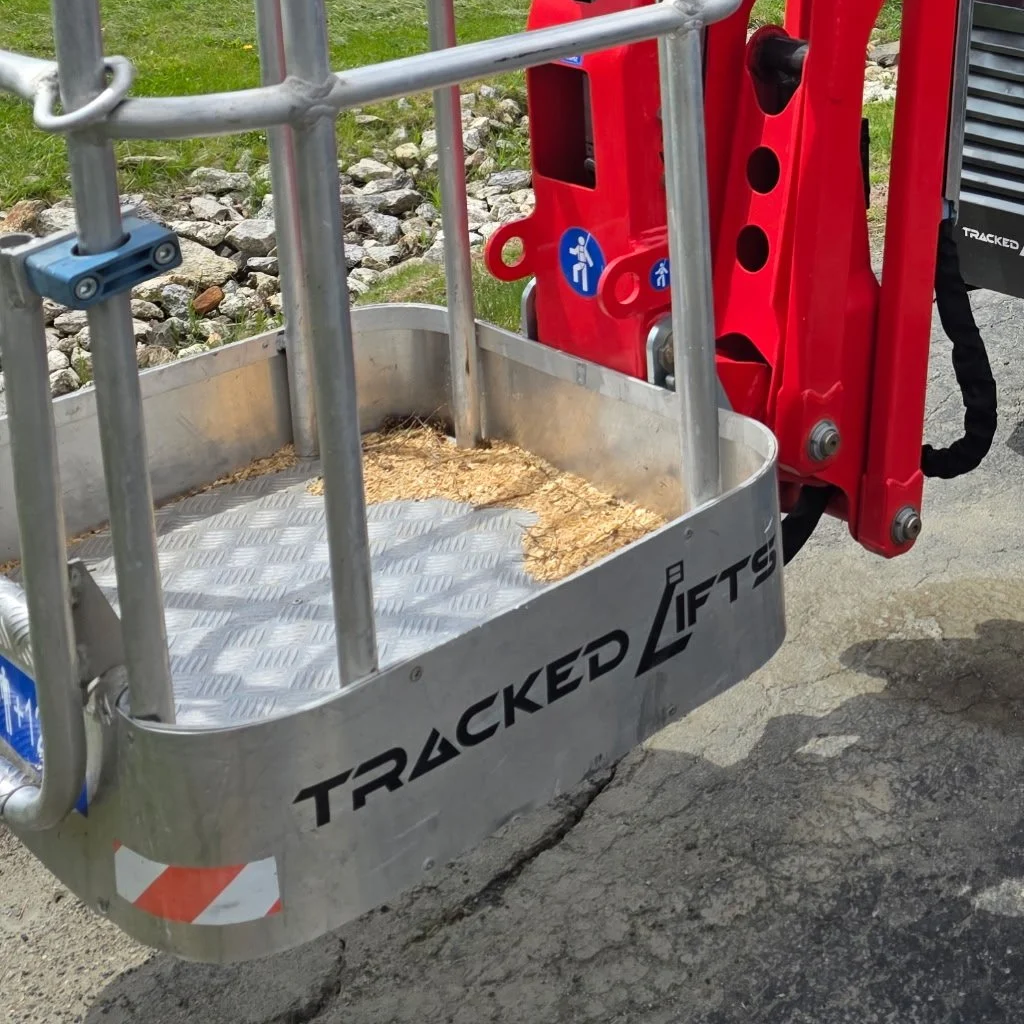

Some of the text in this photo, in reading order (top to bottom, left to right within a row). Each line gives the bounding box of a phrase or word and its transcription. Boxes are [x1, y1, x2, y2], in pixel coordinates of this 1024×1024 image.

[962, 226, 1020, 250] TRACKED
[292, 536, 777, 828] TRACKED LIFTS
